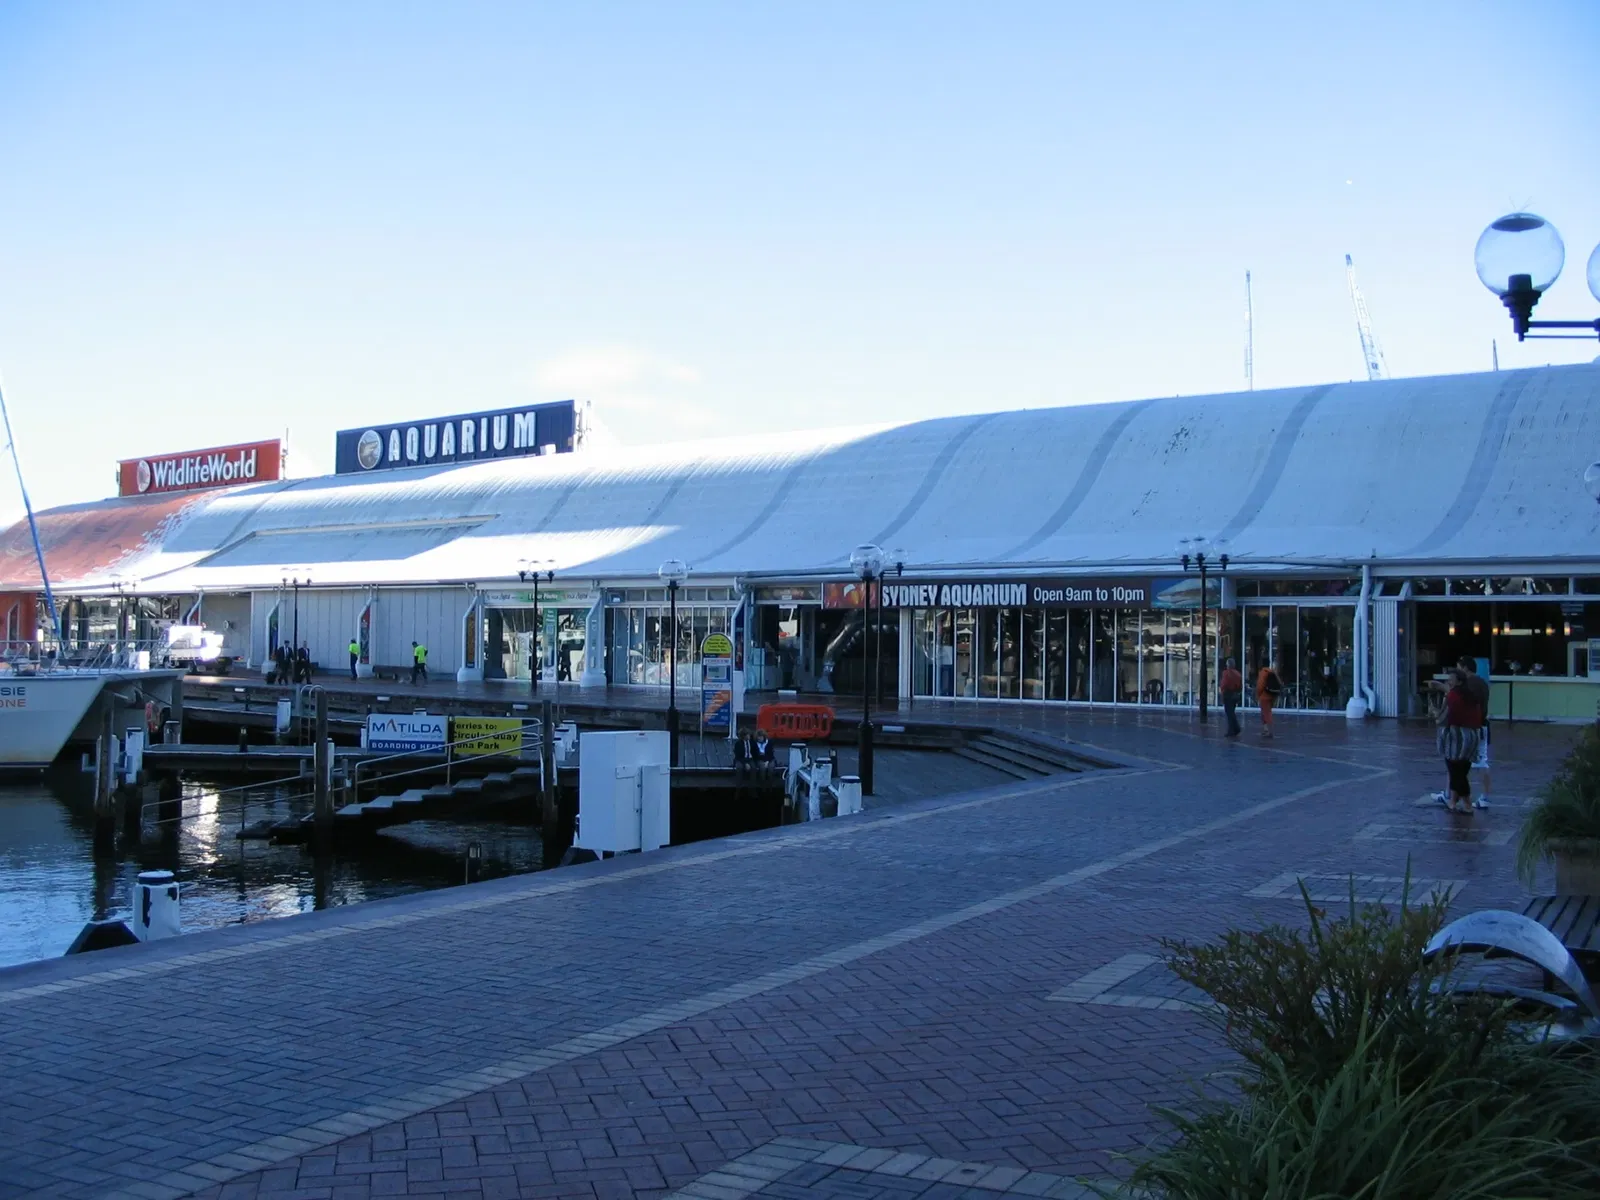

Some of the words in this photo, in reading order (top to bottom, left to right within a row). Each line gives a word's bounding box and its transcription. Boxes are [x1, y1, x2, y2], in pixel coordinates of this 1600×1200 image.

[388, 411, 536, 462] AQUARIUM
[152, 449, 257, 488] WildlifeWorld
[882, 584, 937, 607] SYDNEY
[940, 583, 1027, 608] AQUARIUM
[1033, 587, 1063, 603] Open
[1066, 587, 1092, 602] 9am
[1095, 587, 1108, 602] to
[1111, 586, 1145, 604] 10pm
[372, 718, 443, 734] MATILDA
[454, 721, 483, 730] erries
[372, 742, 417, 750] BOARDING
[477, 741, 500, 749] Park
